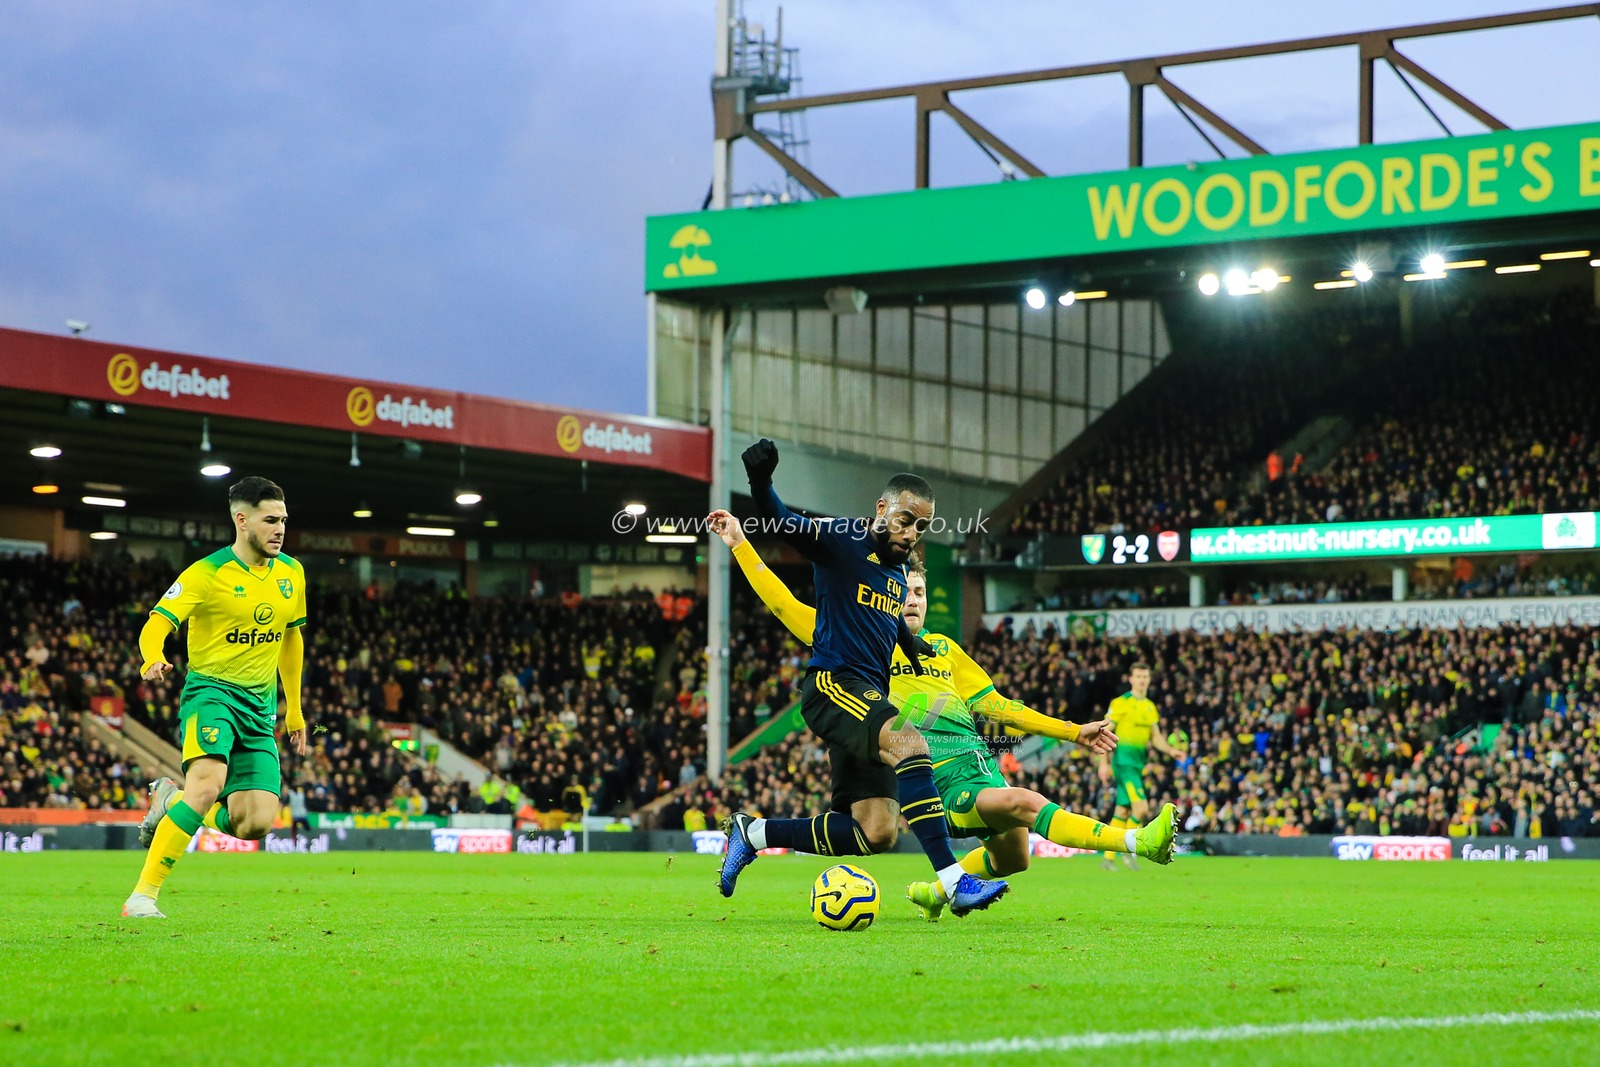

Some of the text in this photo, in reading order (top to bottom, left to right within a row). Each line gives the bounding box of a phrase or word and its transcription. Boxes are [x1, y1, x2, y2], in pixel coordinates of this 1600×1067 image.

[1087, 141, 1554, 241] WOODFORDE'S
[140, 361, 230, 400] dafabet
[376, 394, 454, 429] dafabet
[582, 421, 652, 455] dafabet
[1112, 534, 1150, 565] 2-2
[886, 578, 902, 599] Fly
[1190, 609, 1269, 631] GROUP
[1278, 607, 1385, 629] INSURANCE
[1406, 604, 1500, 624] FINANCIAL
[225, 628, 282, 647] dafabe
[433, 833, 509, 853] sky sports
[517, 834, 545, 853] feel
[557, 834, 576, 853] all
[695, 836, 723, 855] sky
[1337, 841, 1447, 861] sky sports
[1461, 843, 1550, 861] feel it all
